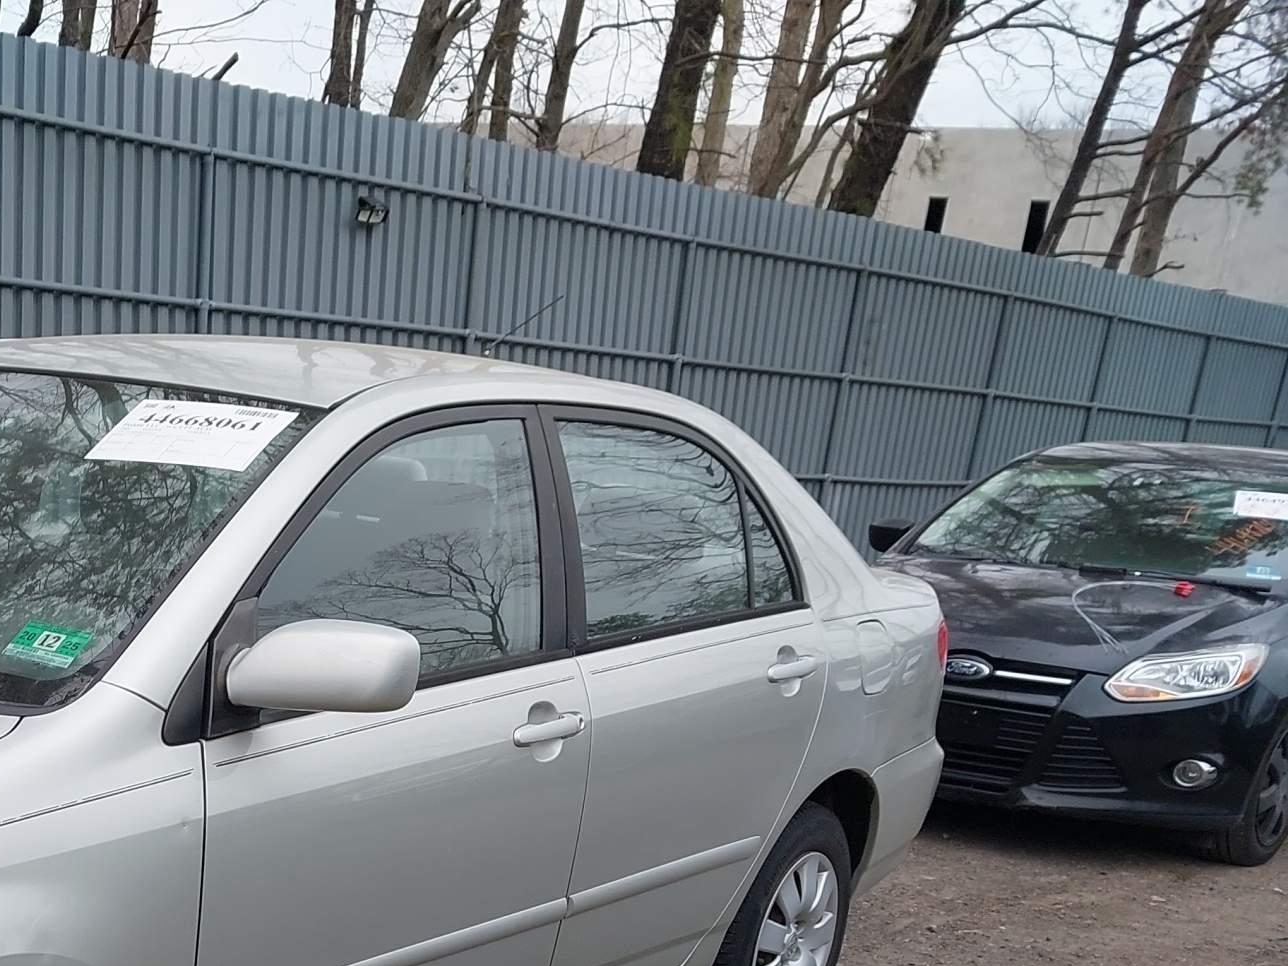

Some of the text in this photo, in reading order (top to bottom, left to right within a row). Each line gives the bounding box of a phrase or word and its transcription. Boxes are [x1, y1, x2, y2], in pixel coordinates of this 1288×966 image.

[139, 412, 263, 431] 44668061
[19, 630, 81, 651] 20 12 25
[947, 661, 978, 675] Ford
